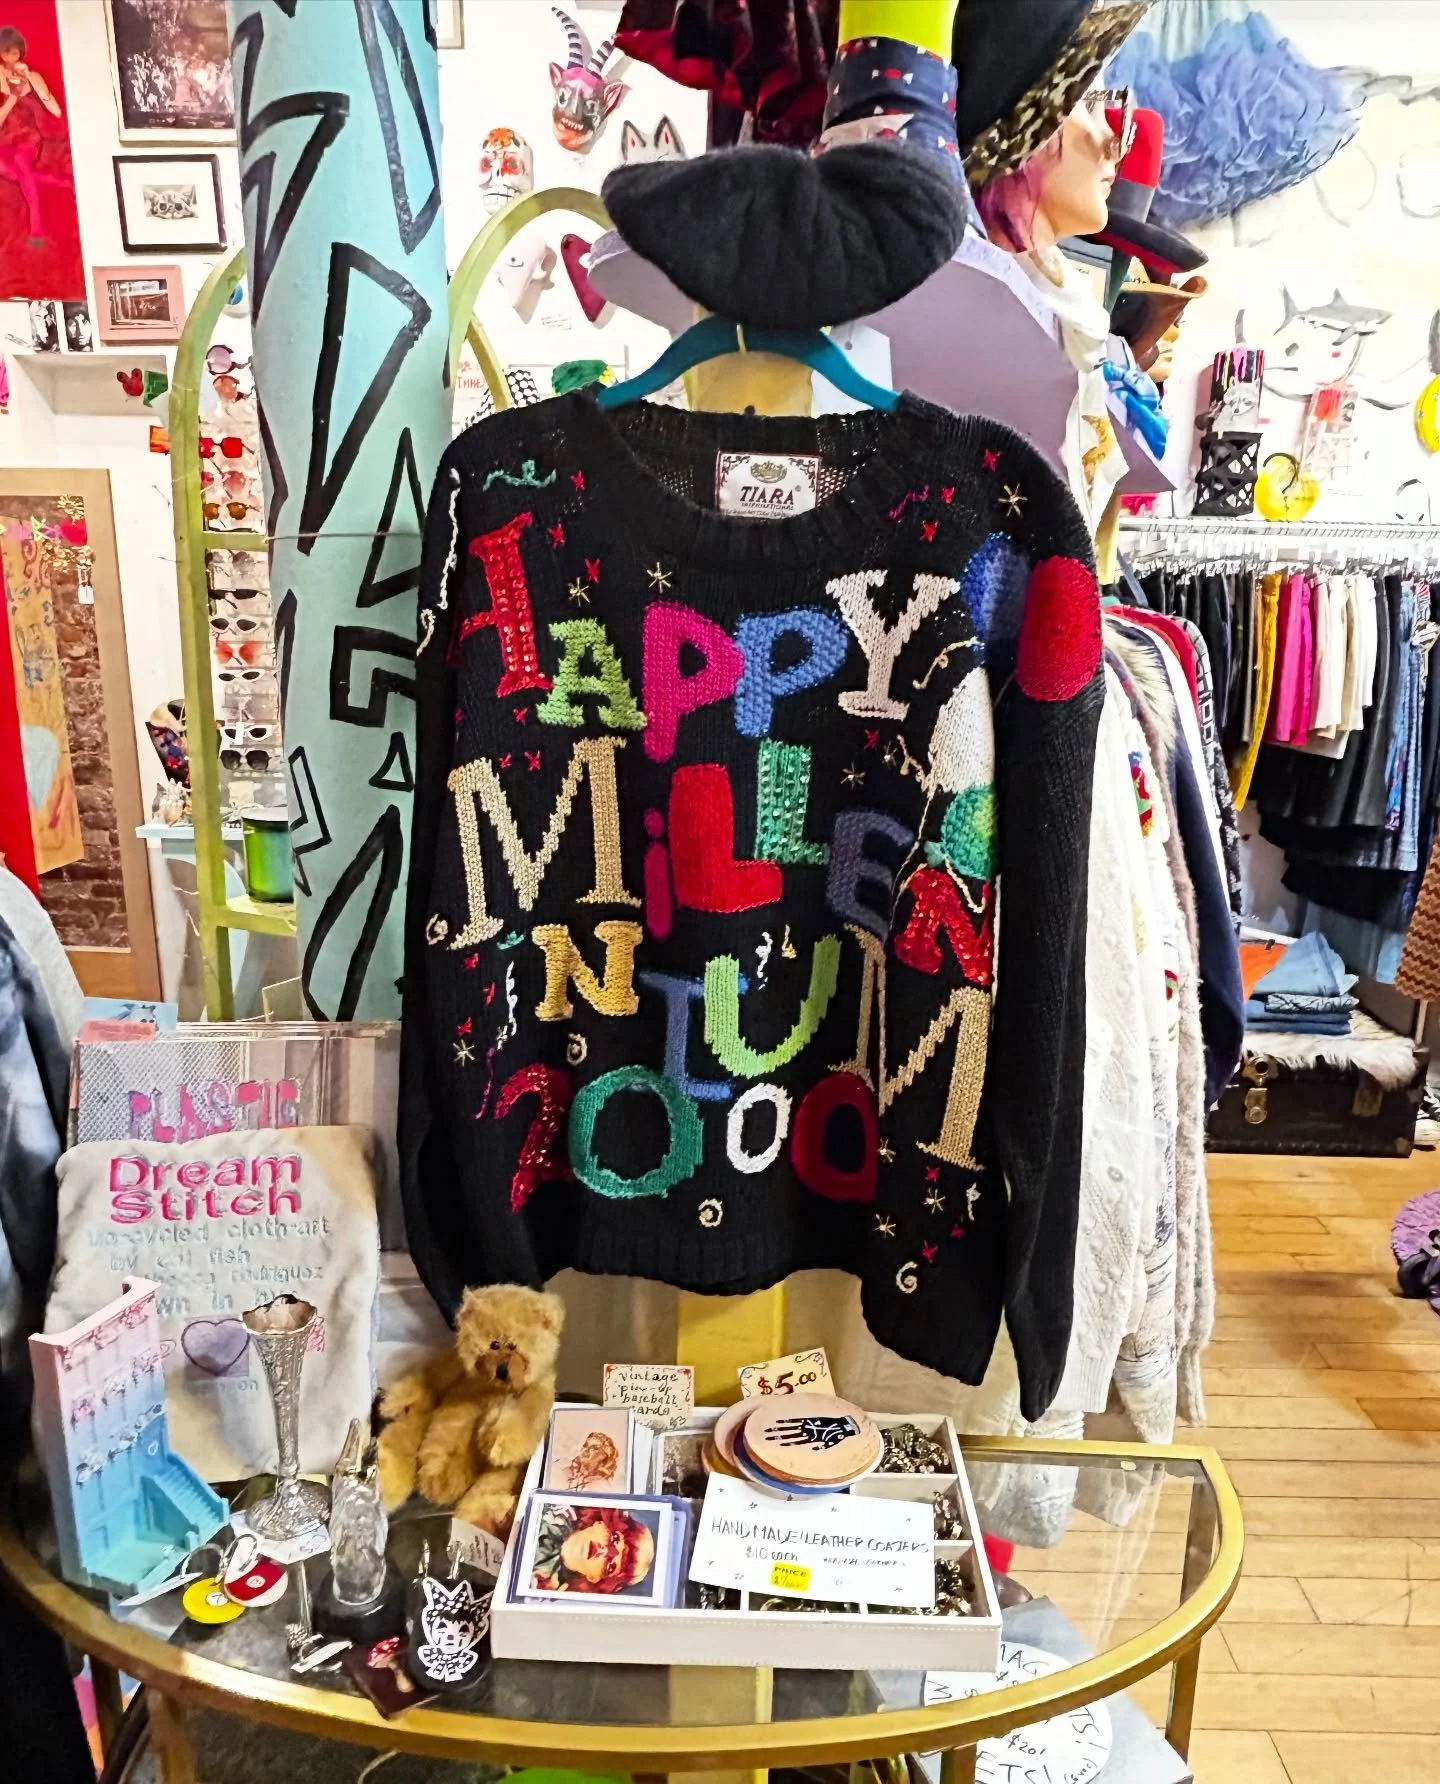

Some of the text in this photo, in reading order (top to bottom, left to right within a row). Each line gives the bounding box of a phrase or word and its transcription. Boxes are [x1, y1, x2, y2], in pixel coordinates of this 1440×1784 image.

[740, 486, 794, 505] TIARA
[494, 1062, 879, 1214] 2000
[109, 1154, 301, 1193] Dream
[110, 1187, 301, 1225] Stitch
[618, 1371, 679, 1386] vintage
[757, 1371, 817, 1396] $5.00
[622, 1393, 677, 1405] baseball
